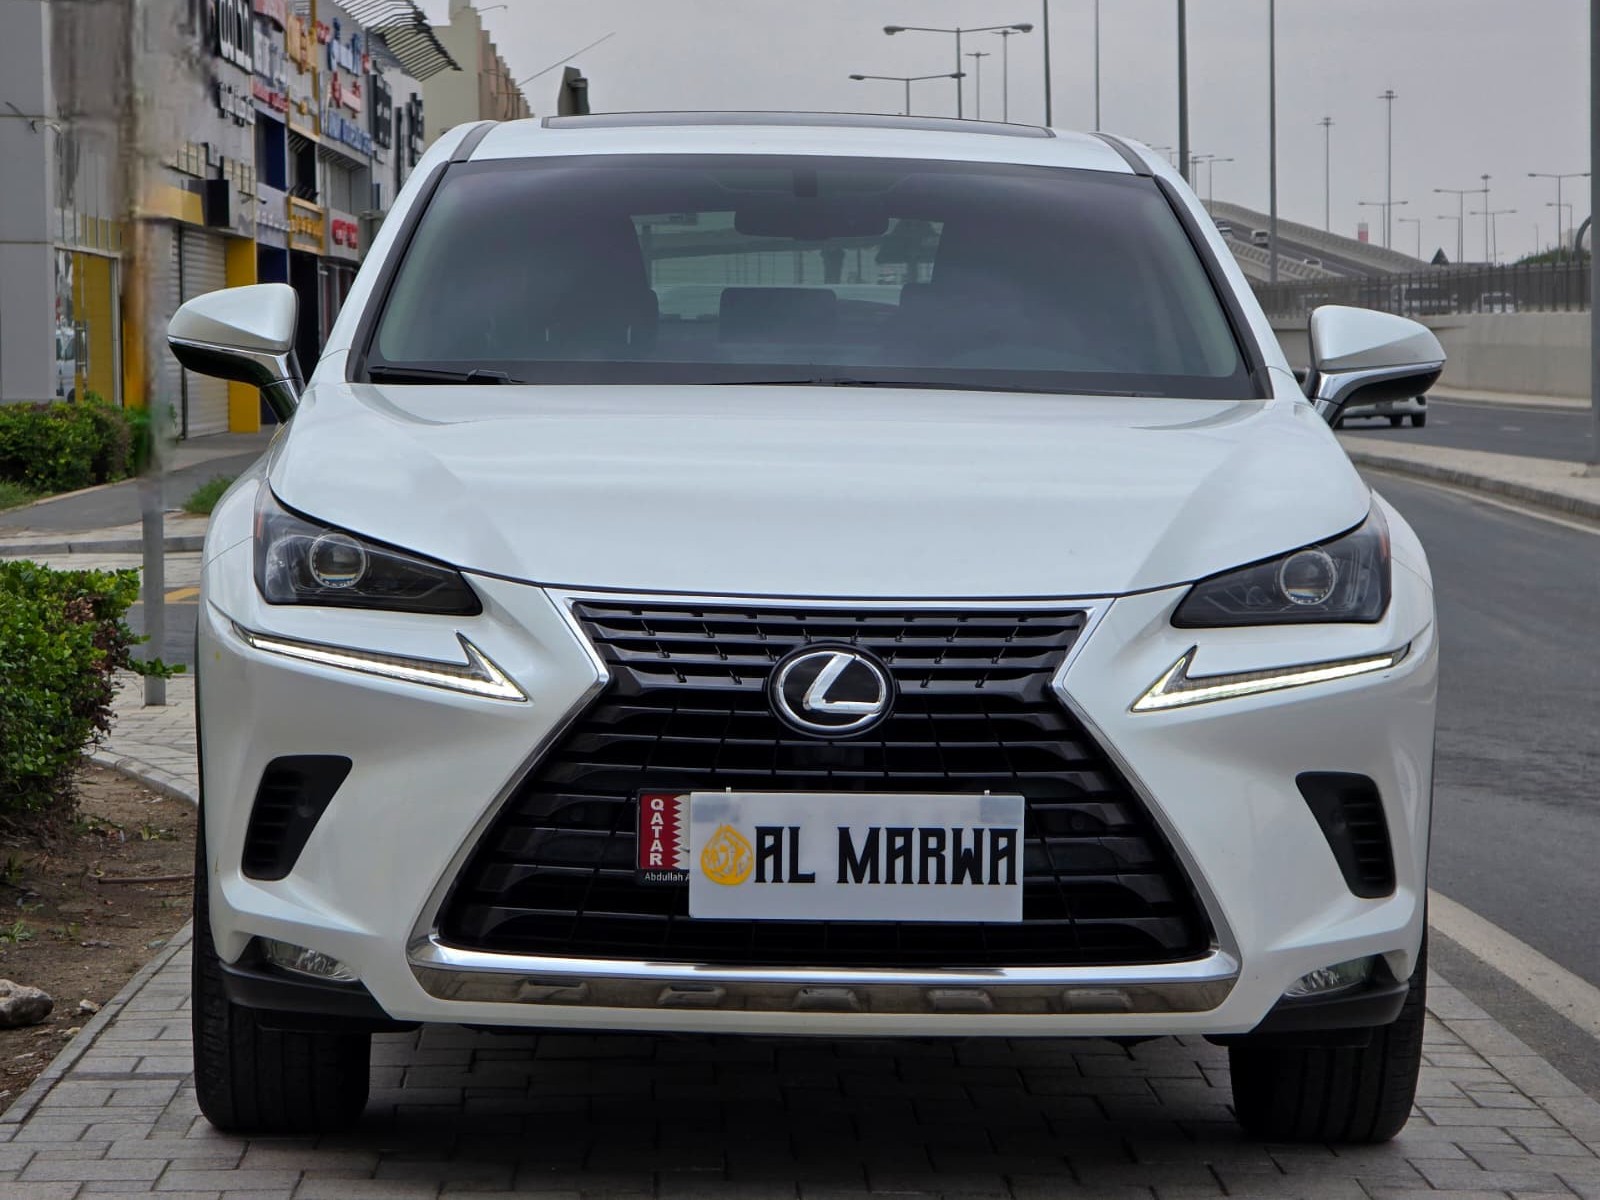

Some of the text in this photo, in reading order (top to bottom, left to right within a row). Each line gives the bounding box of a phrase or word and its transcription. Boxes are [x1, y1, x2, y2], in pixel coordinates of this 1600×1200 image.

[649, 798, 665, 866] QATAR
[754, 826, 816, 884] AL
[836, 826, 1018, 885] MARWA
[644, 871, 684, 882] Abdullah
